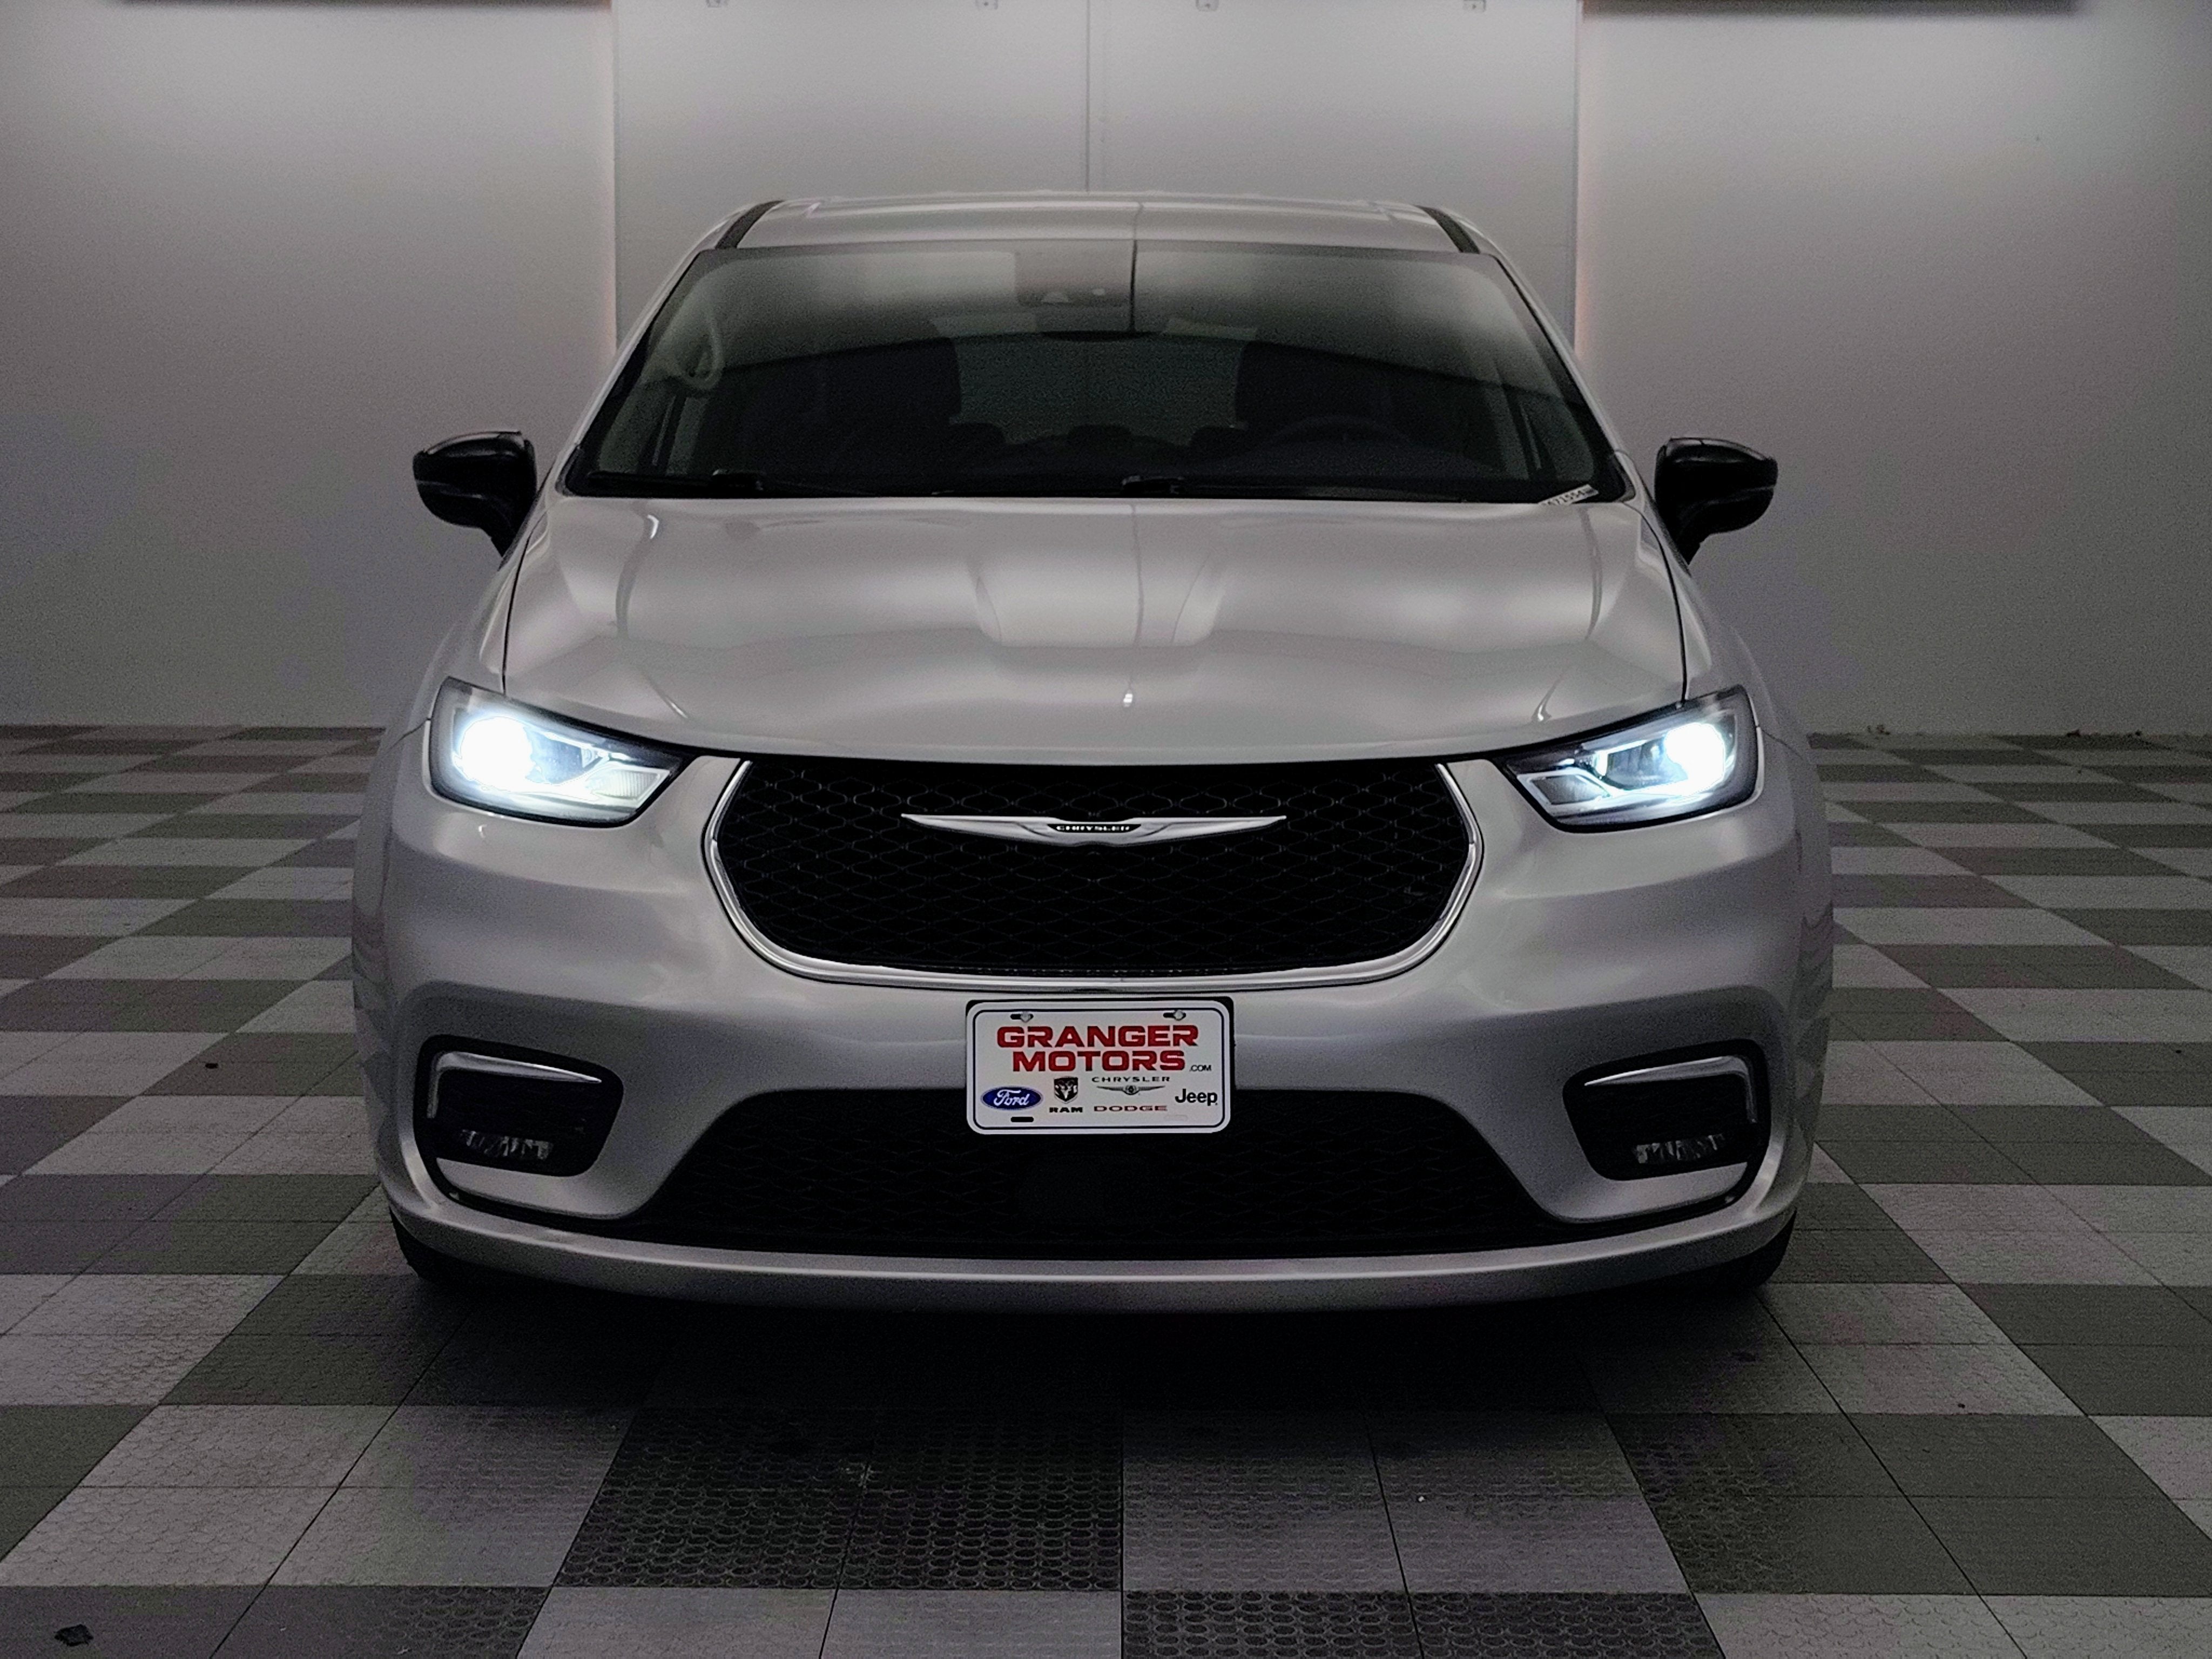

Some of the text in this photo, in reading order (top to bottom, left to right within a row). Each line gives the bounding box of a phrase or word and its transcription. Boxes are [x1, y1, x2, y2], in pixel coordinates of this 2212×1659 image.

[997, 1025, 1198, 1048] GRANGER
[1013, 1050, 1185, 1071] MOTORS
[993, 1089, 1030, 1106] Ford
[1175, 1088, 1218, 1106] Jeep
